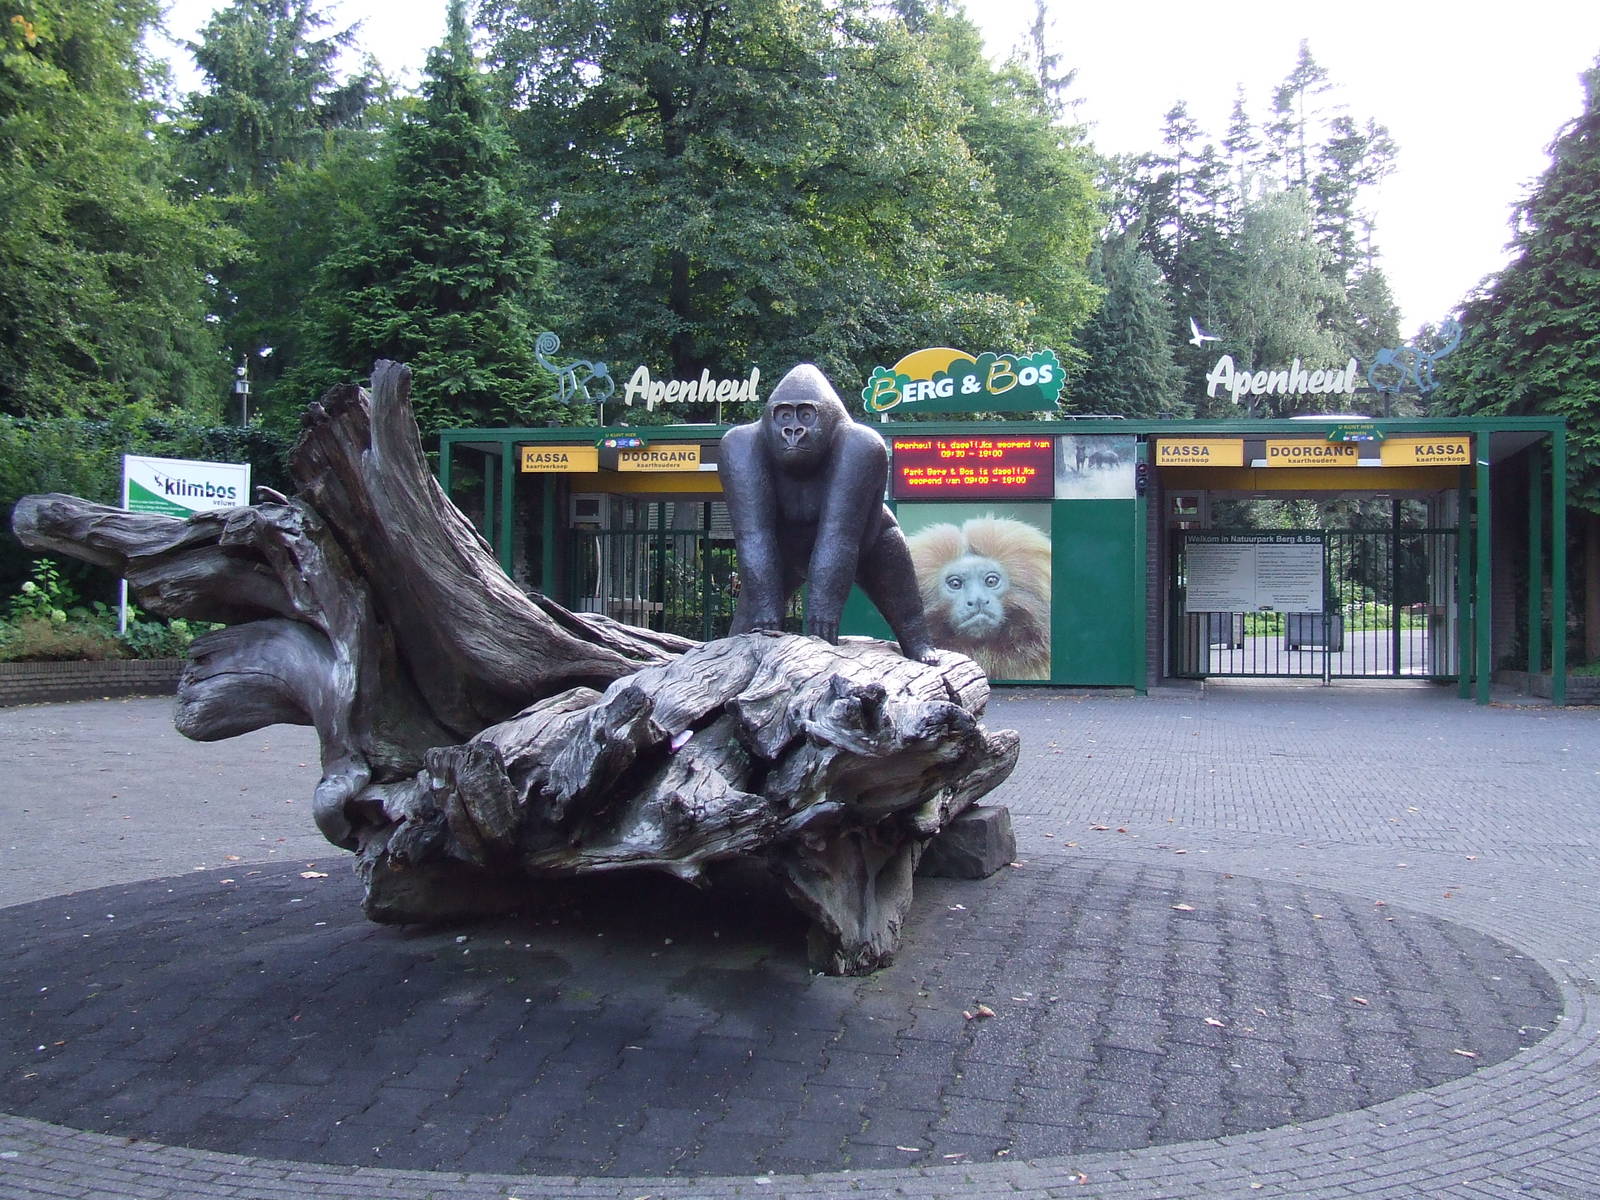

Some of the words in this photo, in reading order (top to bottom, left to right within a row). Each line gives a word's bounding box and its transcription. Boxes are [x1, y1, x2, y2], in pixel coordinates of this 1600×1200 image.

[960, 374, 982, 395] &
[1205, 354, 1358, 405] Apenheul
[623, 365, 761, 413] Apenheul
[894, 441, 932, 450] Apenheul
[937, 440, 946, 449] is
[950, 440, 993, 449] dagelijks
[997, 440, 1031, 449] geopend
[1035, 440, 1050, 448] van
[1415, 445, 1465, 456] KASSA
[622, 451, 697, 462] DOORGANG
[1161, 445, 1210, 457] KASSA
[1270, 445, 1355, 457] DOORGANG
[526, 453, 569, 463] KASSA
[1161, 457, 1210, 465] kaartverkoop
[903, 467, 923, 476] Park
[927, 467, 947, 476] Berg
[959, 467, 975, 476] Bos
[979, 467, 988, 475] is
[992, 467, 1036, 475] dagelijks
[908, 477, 942, 486] geopend
[945, 477, 961, 485] van
[165, 478, 237, 500] klimbos
[1188, 535, 1219, 543] Welkom
[1221, 535, 1229, 543] in
[1230, 535, 1275, 544] Natuurpark
[1276, 535, 1296, 544] Berg
[1297, 535, 1303, 543] &
[1305, 535, 1321, 543] Bos
